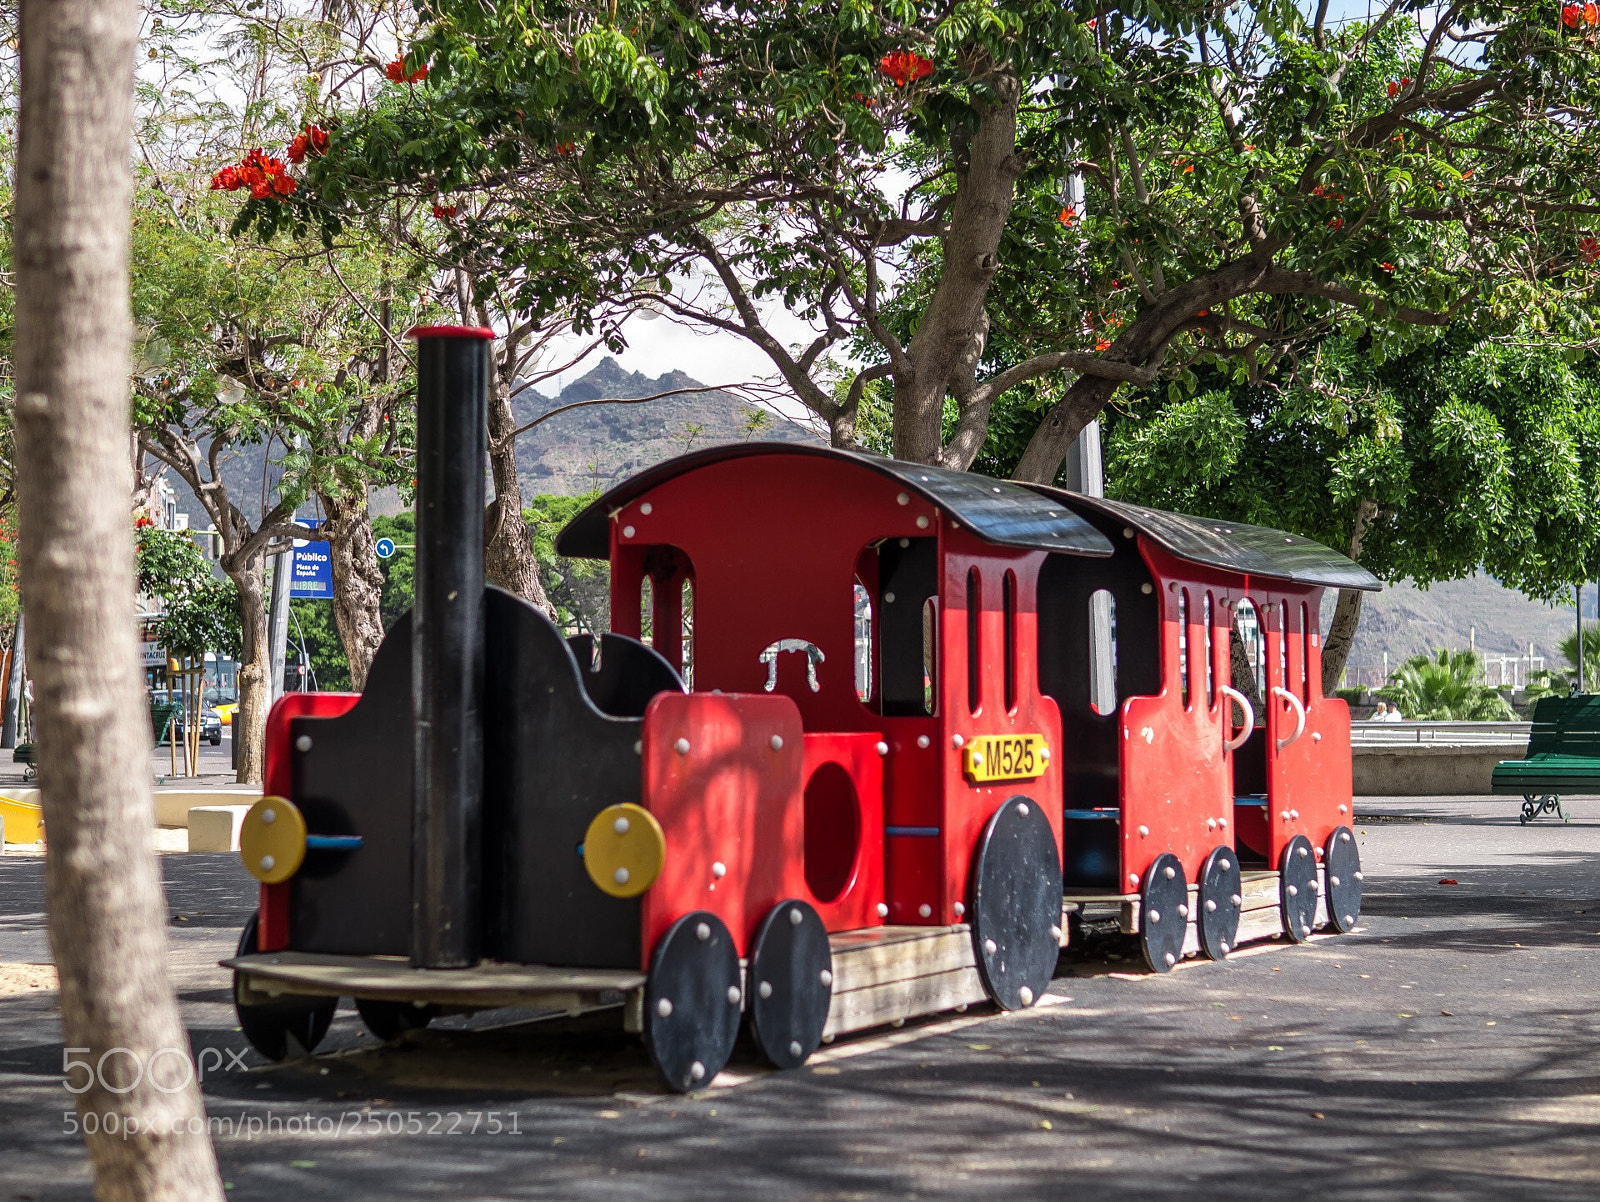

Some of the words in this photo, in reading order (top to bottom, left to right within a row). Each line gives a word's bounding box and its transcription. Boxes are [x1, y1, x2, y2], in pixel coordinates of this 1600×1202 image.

[296, 552, 327, 561] Público
[294, 581, 317, 590] LIBRE
[986, 739, 1034, 776] M525
